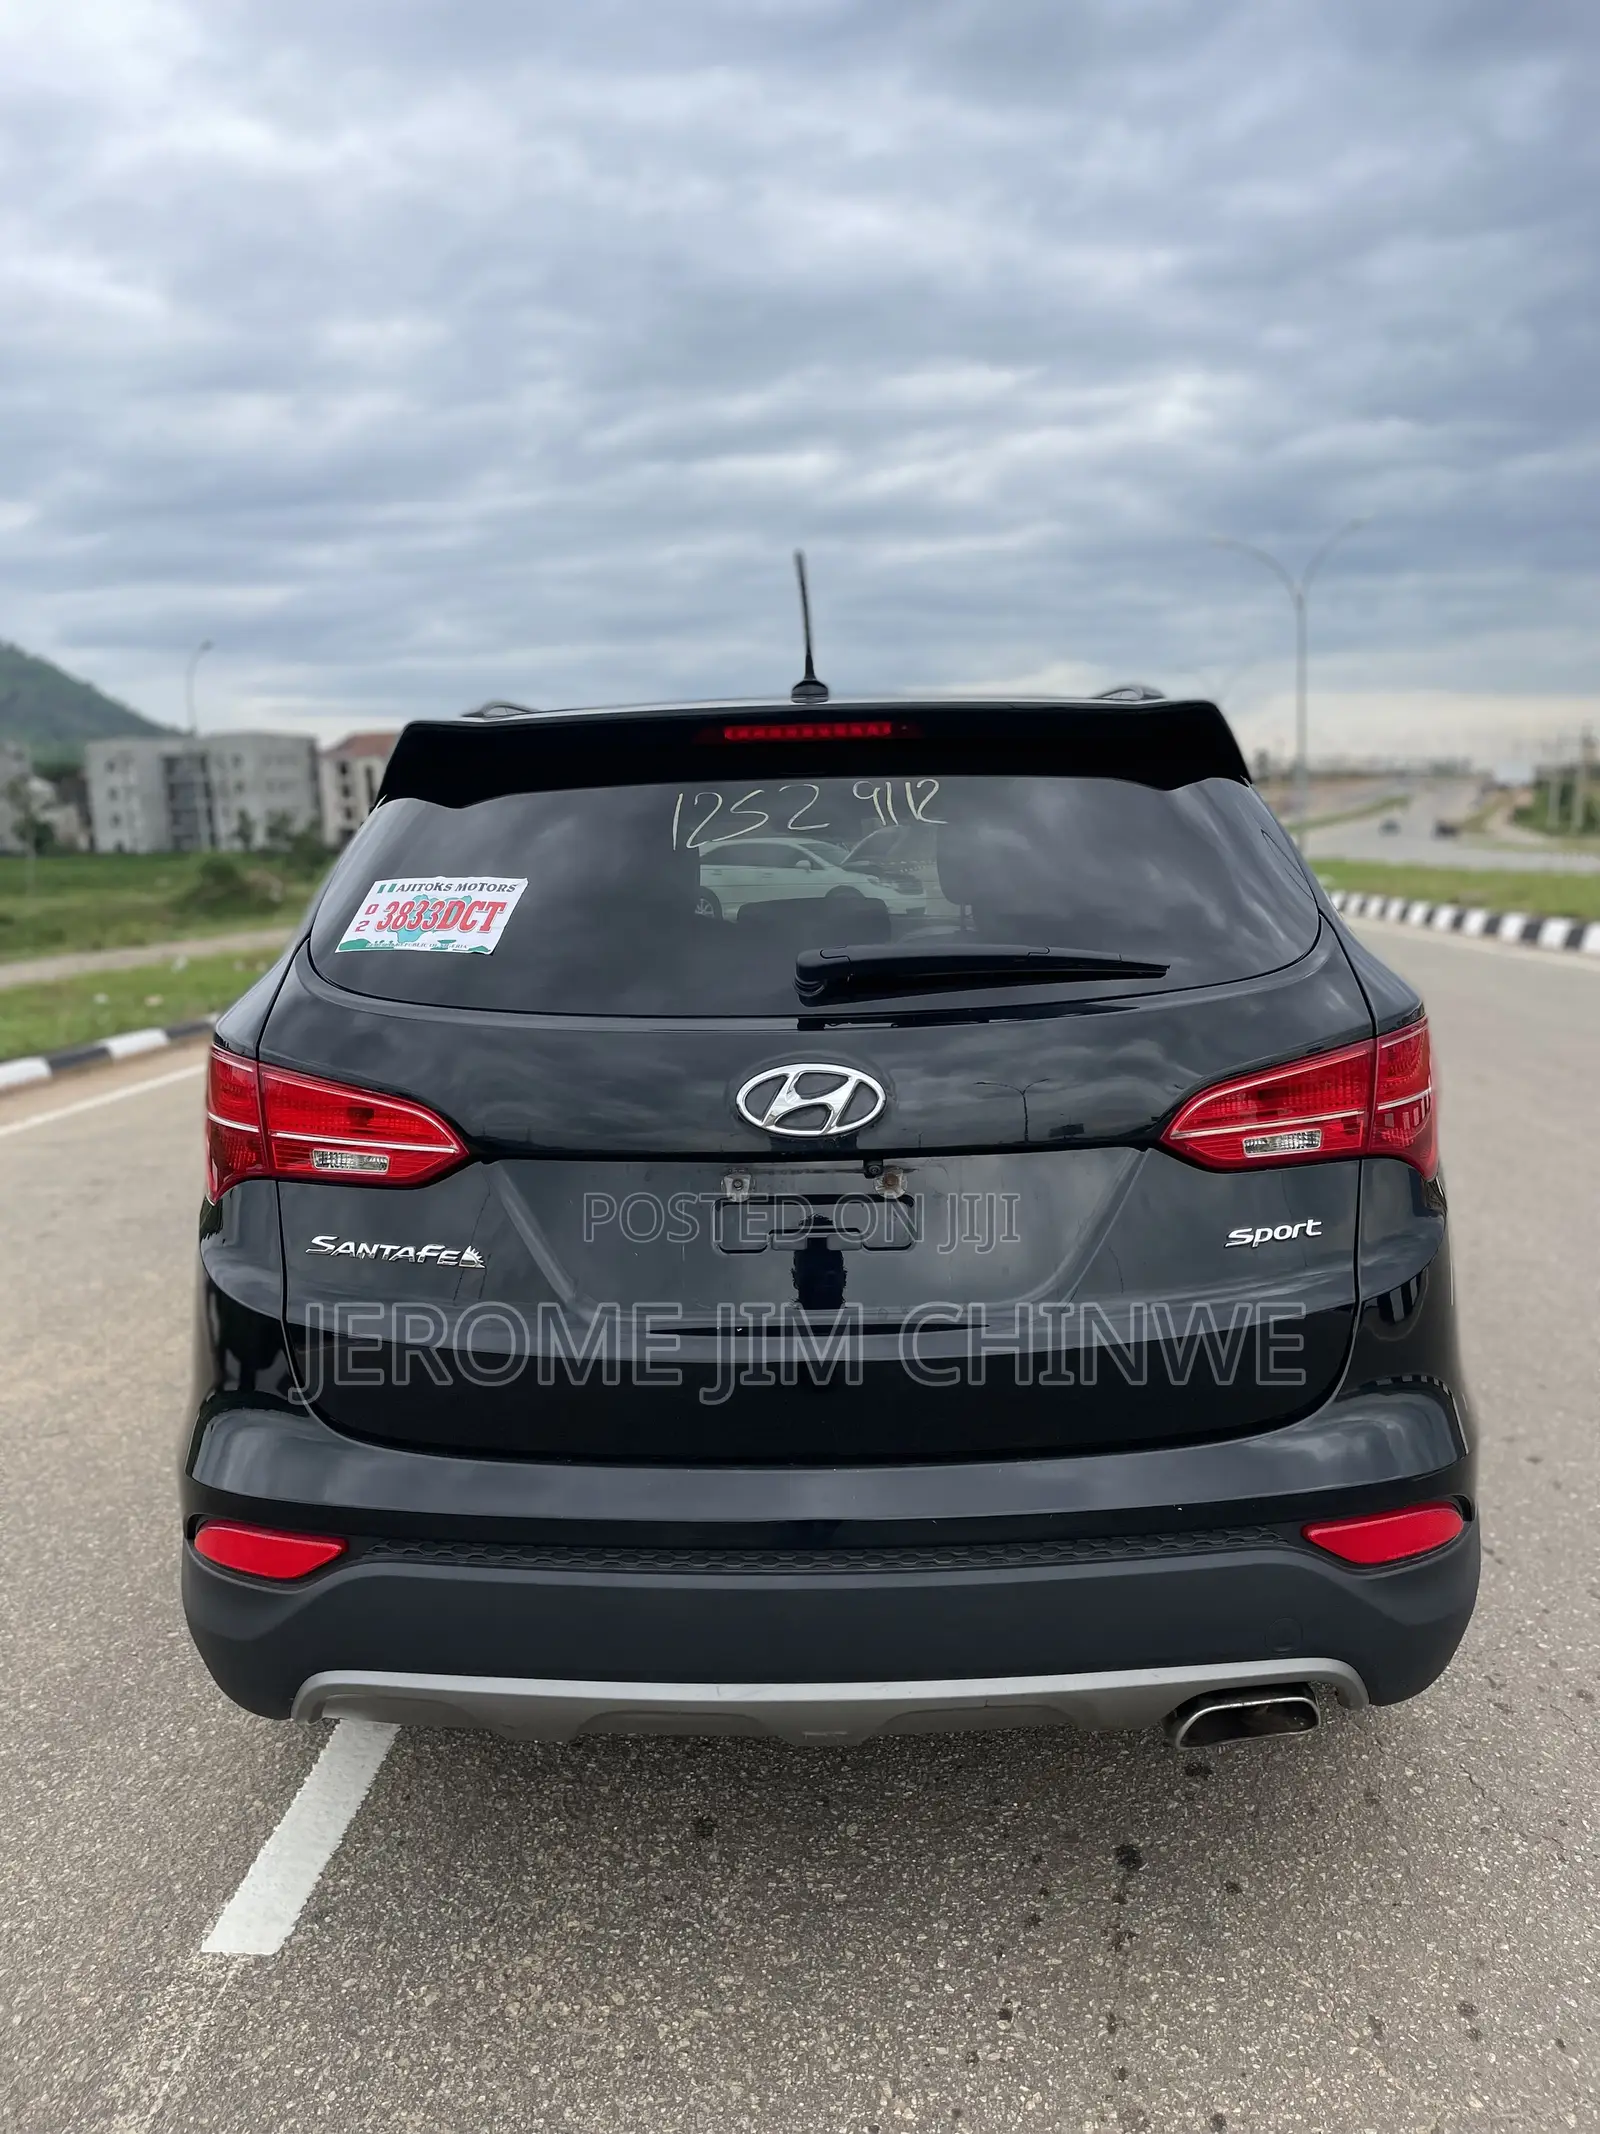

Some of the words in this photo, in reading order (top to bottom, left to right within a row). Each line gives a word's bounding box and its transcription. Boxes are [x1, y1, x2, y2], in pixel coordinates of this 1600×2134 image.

[852, 779, 948, 826] 9112
[455, 882, 517, 893] MOTORS
[375, 900, 507, 933] 3833DCT
[1224, 1219, 1322, 1248] Sport
